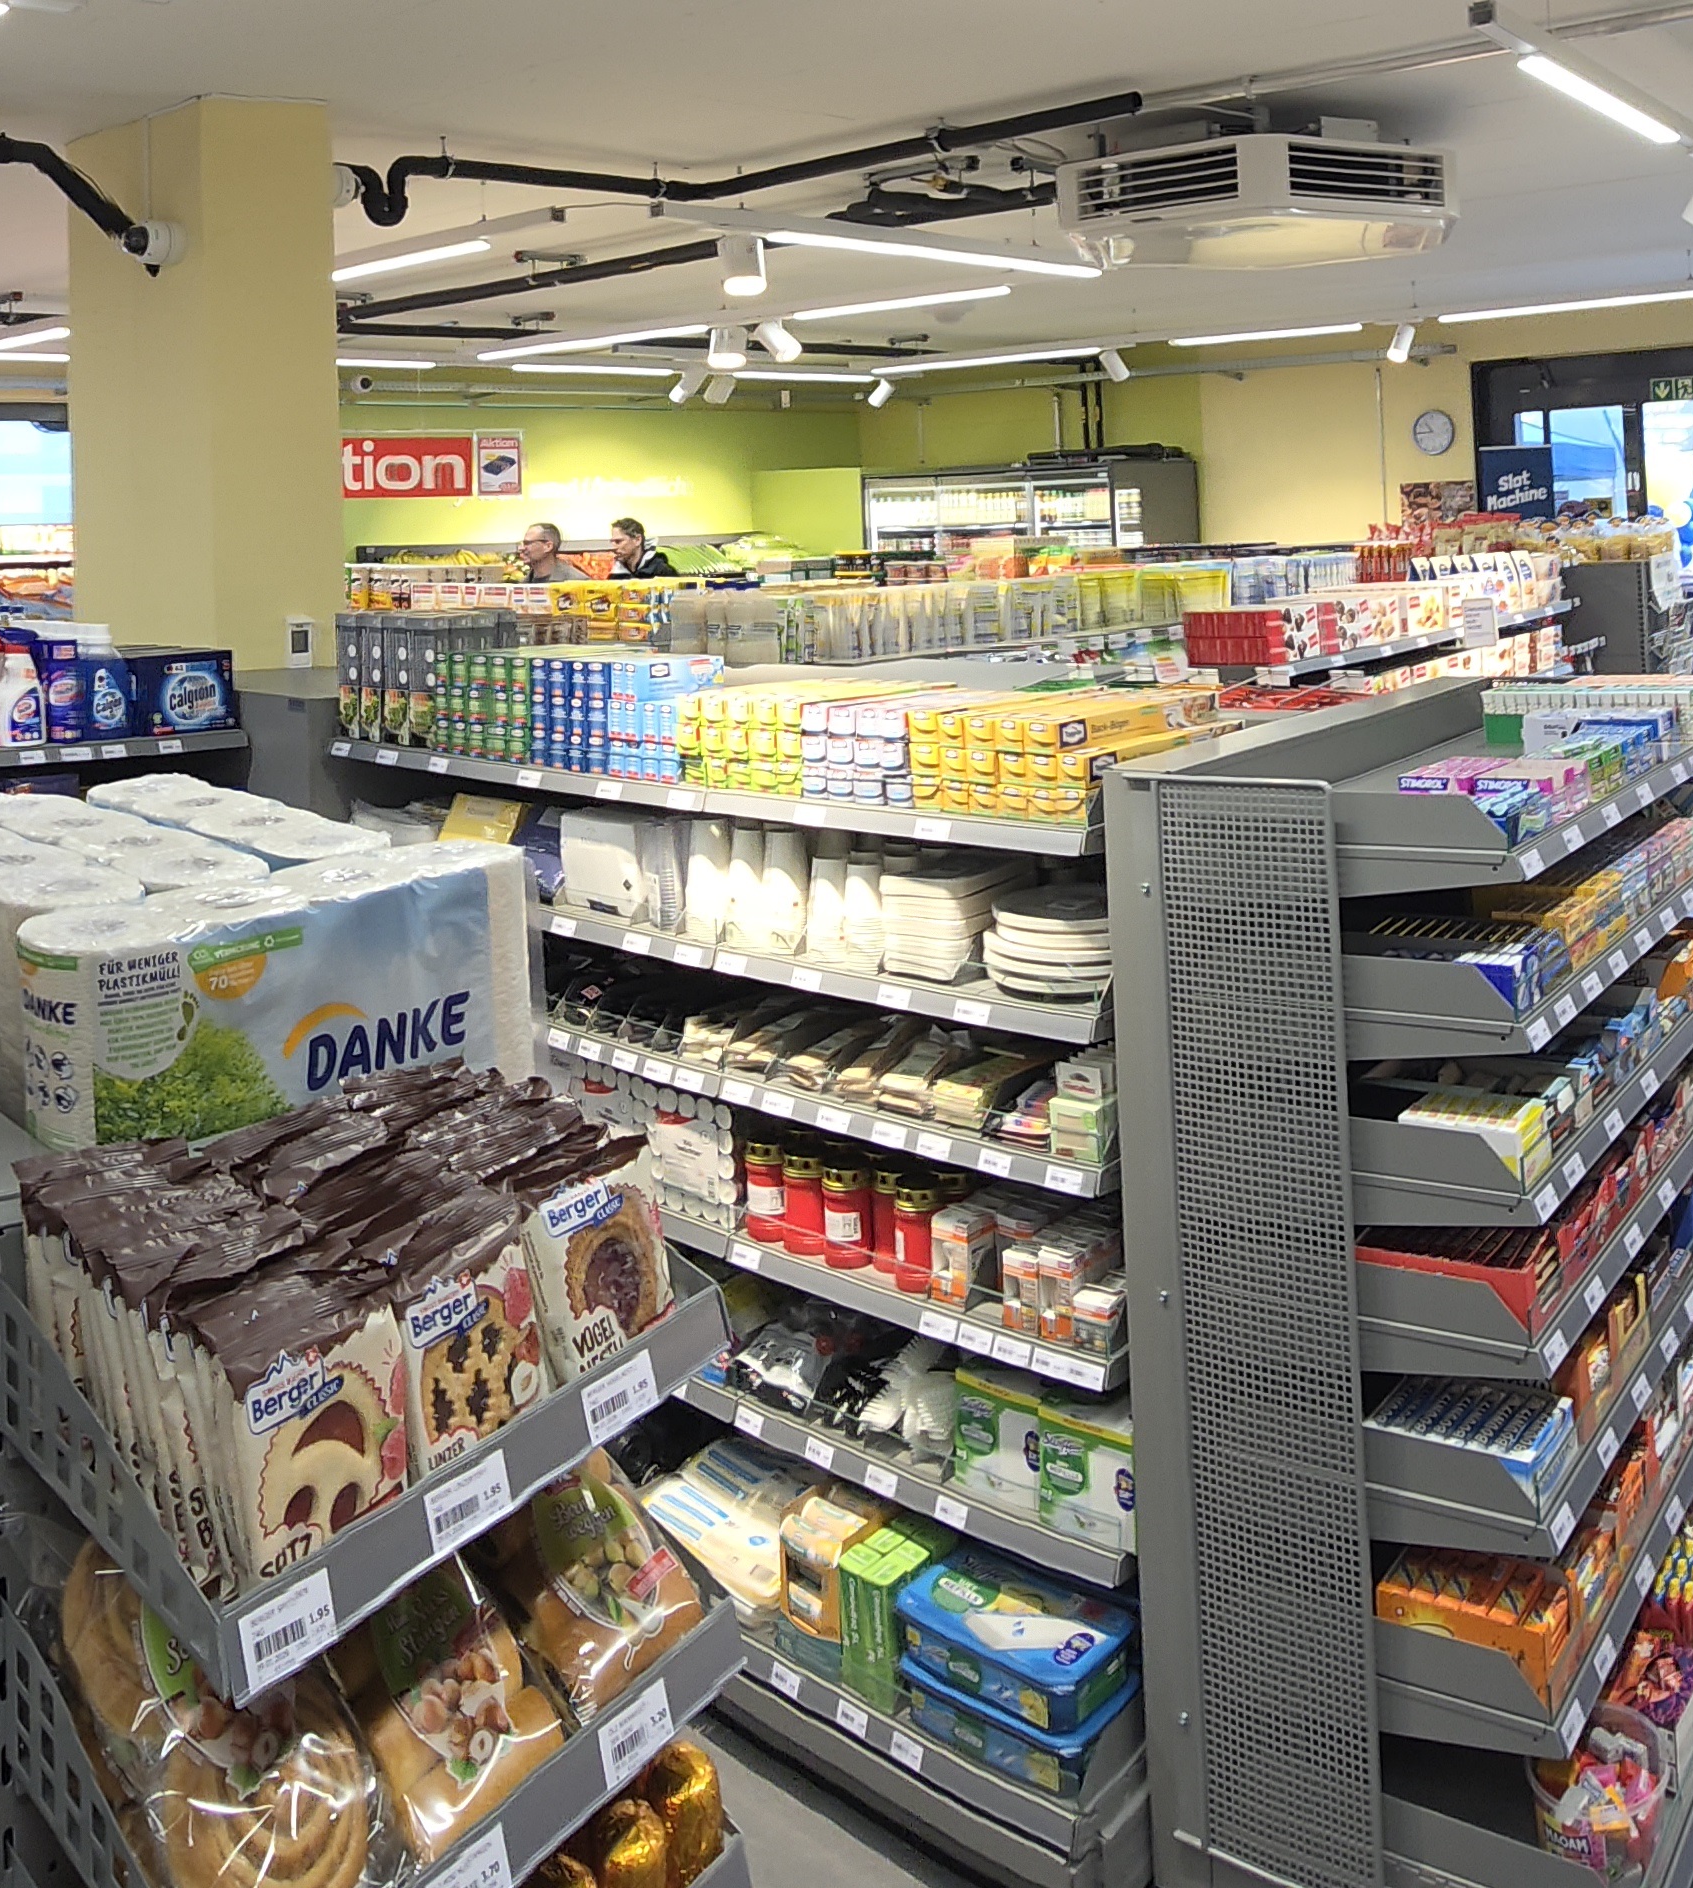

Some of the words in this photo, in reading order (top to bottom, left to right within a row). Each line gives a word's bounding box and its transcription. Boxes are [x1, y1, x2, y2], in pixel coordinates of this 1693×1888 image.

[341, 440, 466, 491] tion
[1496, 470, 1532, 491] Slot
[1486, 484, 1548, 512] Machine
[98, 957, 125, 975] FÜR
[127, 950, 179, 972] WENIGER
[97, 965, 181, 992] PLASTIKMÜLL!
[304, 990, 471, 1092] DANKE
[545, 1186, 603, 1229] Berger
[410, 1292, 474, 1339] Berger
[251, 1367, 320, 1424] Berger
[632, 1379, 649, 1395] 1.95
[427, 1437, 467, 1471] LINZER
[308, 1604, 331, 1625] 1.95
[649, 1707, 669, 1727] 3.20
